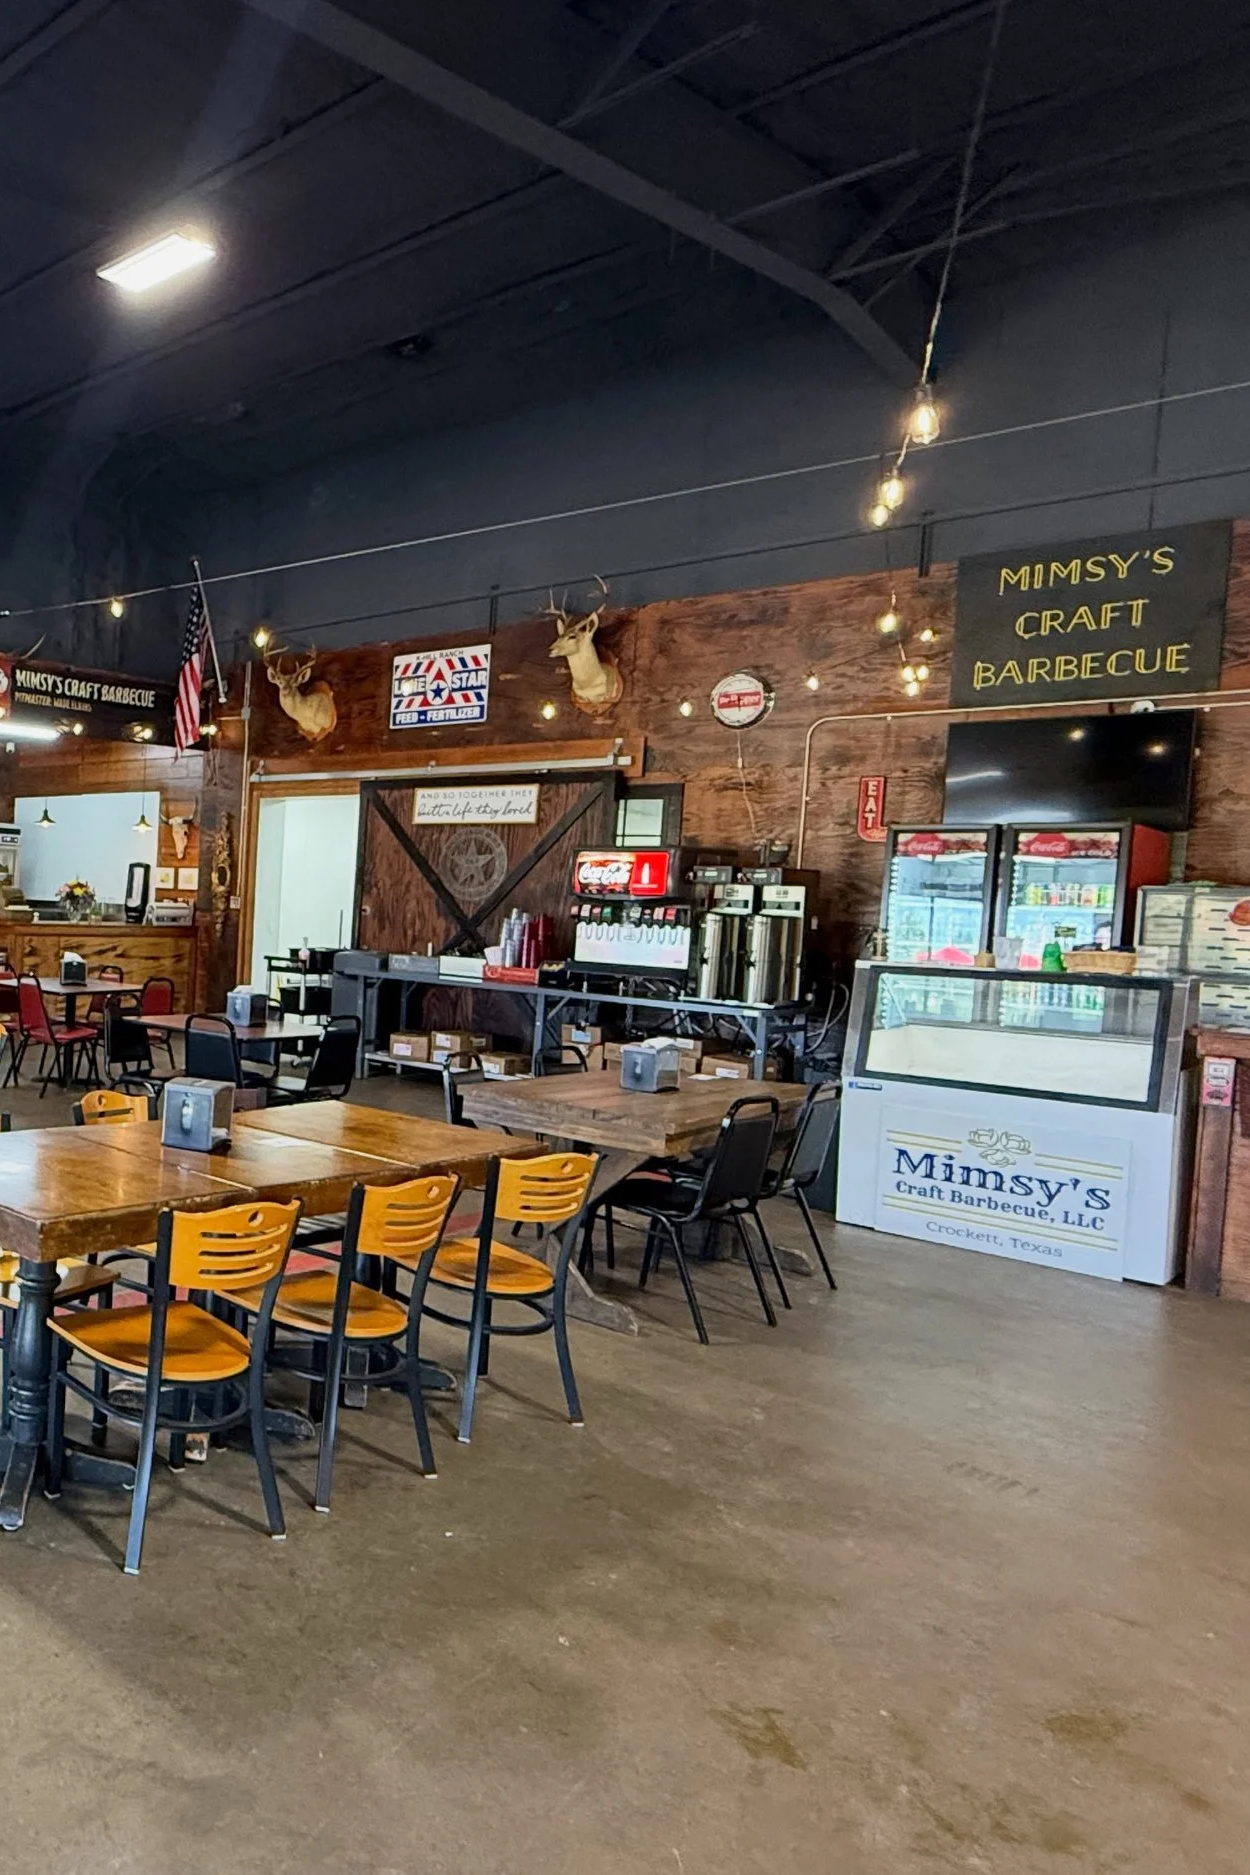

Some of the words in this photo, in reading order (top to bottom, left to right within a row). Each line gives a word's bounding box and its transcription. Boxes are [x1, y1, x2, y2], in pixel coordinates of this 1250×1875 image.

[998, 546, 1175, 596] MIMSY'S
[1015, 598, 1149, 640] CRAFT
[439, 650, 464, 658] RANCH
[973, 643, 1190, 690] BARBECUE
[15, 668, 63, 694] MIMSY'S
[64, 678, 101, 700] CRAFT
[101, 684, 156, 708] BARBECUE
[451, 669, 488, 690] STAR
[395, 712, 419, 725] FEED
[426, 706, 481, 722] FERTILIZER
[421, 791, 439, 799] AND
[442, 791, 455, 799] SO
[459, 789, 506, 799] TOGETHER
[511, 788, 533, 797] THEY
[474, 803, 501, 819] they
[502, 800, 534, 816] loved
[864, 781, 878, 828] EAT
[892, 1147, 1111, 1211] Mimsy's
[895, 1180, 945, 1201] Craft
[950, 1190, 1056, 1223] Barbecue,
[1062, 1210, 1106, 1232] LLC
[926, 1221, 1004, 1248] Crockett,
[1009, 1237, 1064, 1258] Texas
